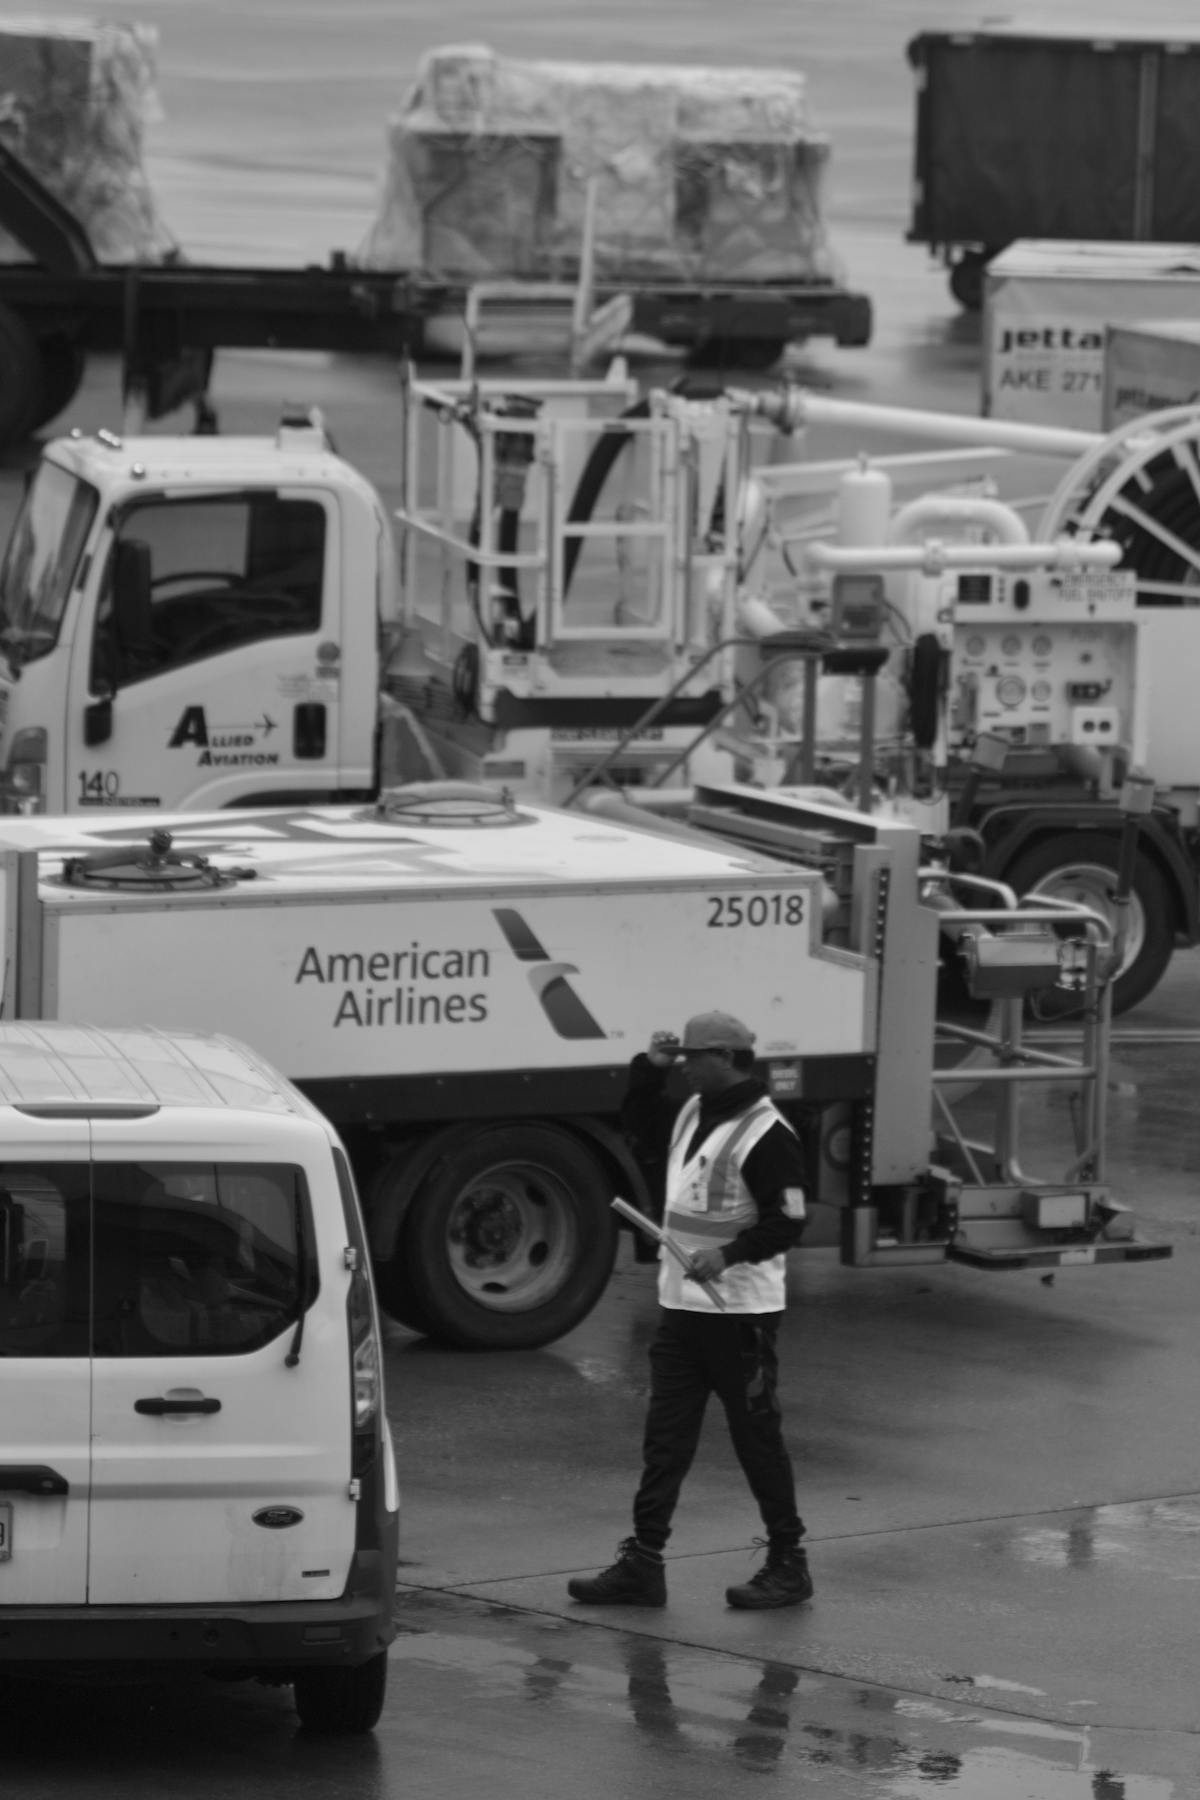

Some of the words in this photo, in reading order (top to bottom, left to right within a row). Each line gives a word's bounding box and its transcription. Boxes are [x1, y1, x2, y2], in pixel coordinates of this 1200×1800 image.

[1000, 369, 1050, 390] AKE
[167, 705, 254, 748] ALLIED
[197, 750, 279, 767] AVIATION
[79, 770, 119, 797] 140
[707, 895, 804, 928] 25018
[294, 942, 490, 985] American
[333, 986, 488, 1027] Airlines
